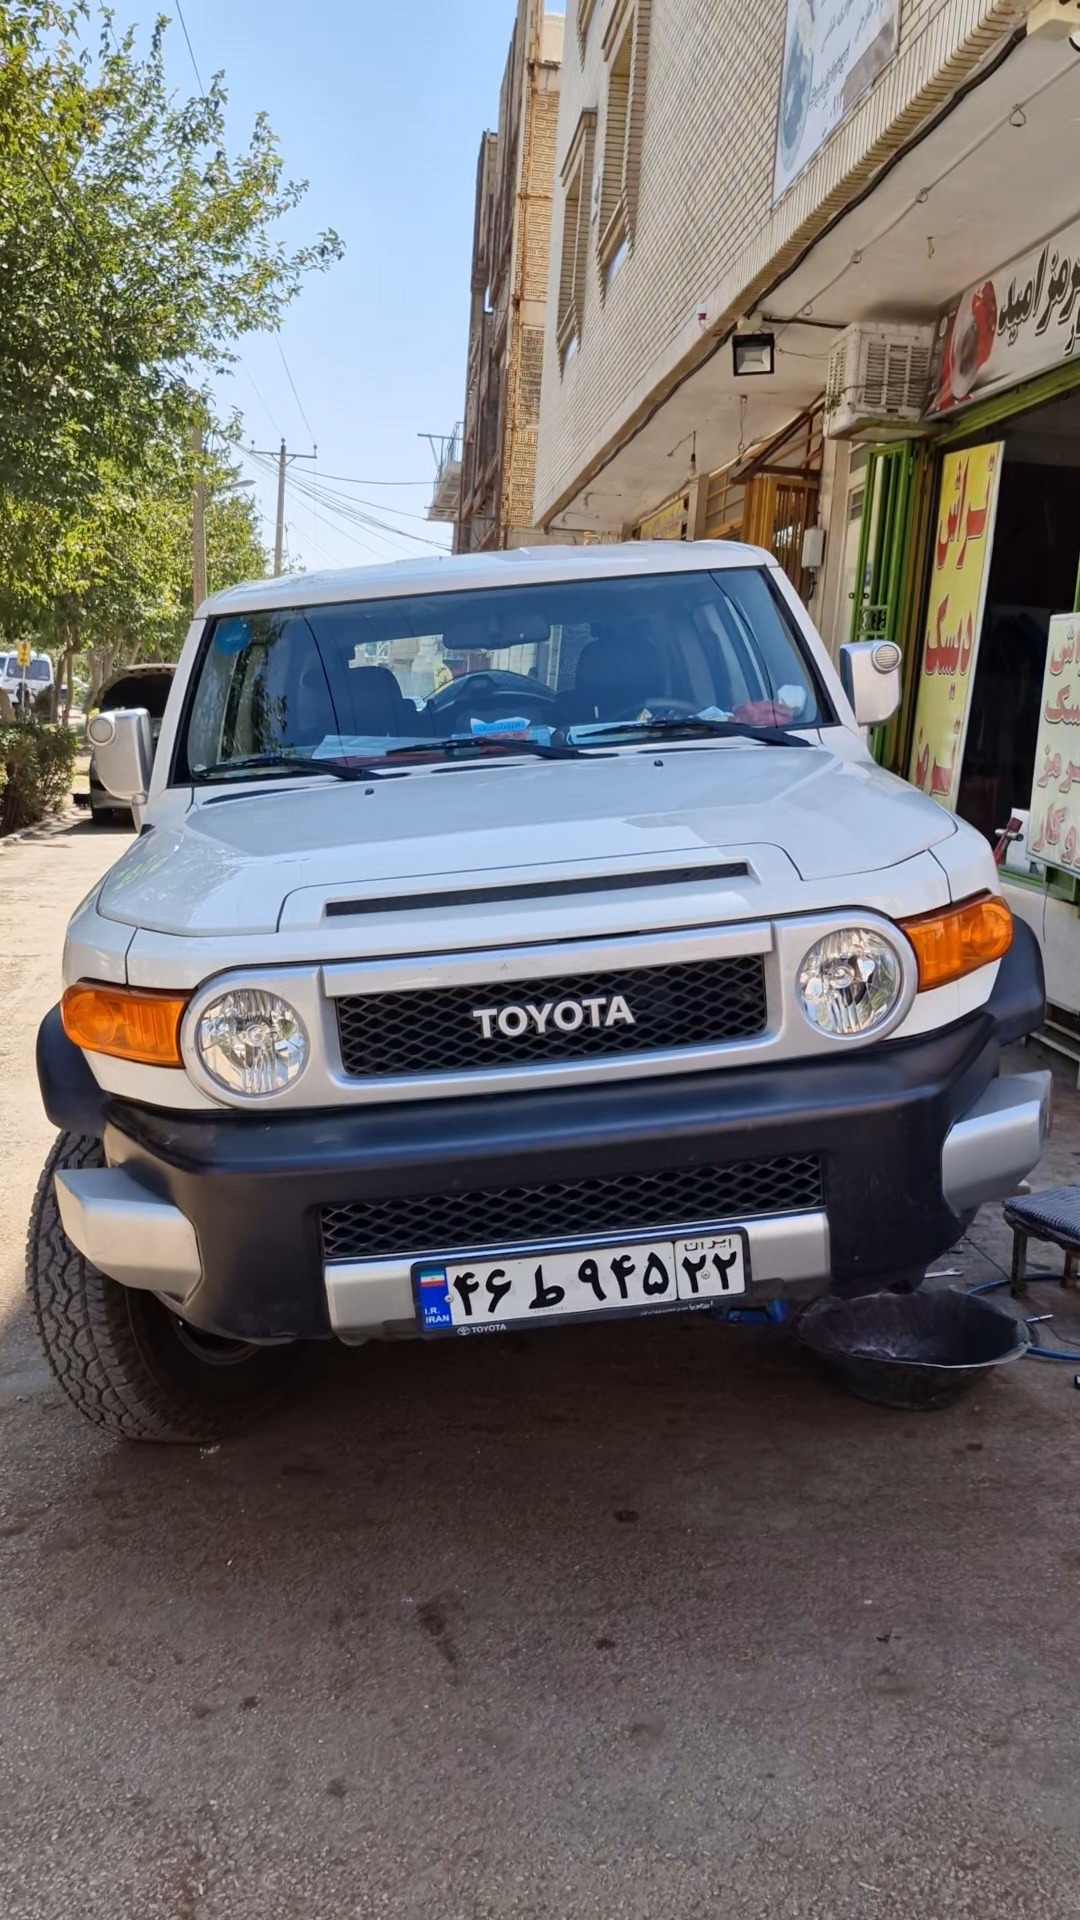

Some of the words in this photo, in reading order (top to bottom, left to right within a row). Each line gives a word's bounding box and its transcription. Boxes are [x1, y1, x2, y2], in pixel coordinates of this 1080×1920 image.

[997, 241, 1050, 348] امید
[1035, 250, 1080, 336] رمز
[936, 454, 996, 571] تراش
[924, 593, 973, 700] دیسک
[1037, 743, 1080, 794] رمز
[472, 995, 636, 1039] TOYOTA
[684, 1238, 731, 1251] ایران
[682, 1250, 737, 1294] ۲۲
[424, 1307, 440, 1316] I.R.
[425, 1314, 450, 1324] IRAN
[471, 1323, 507, 1334] TOYOTA
